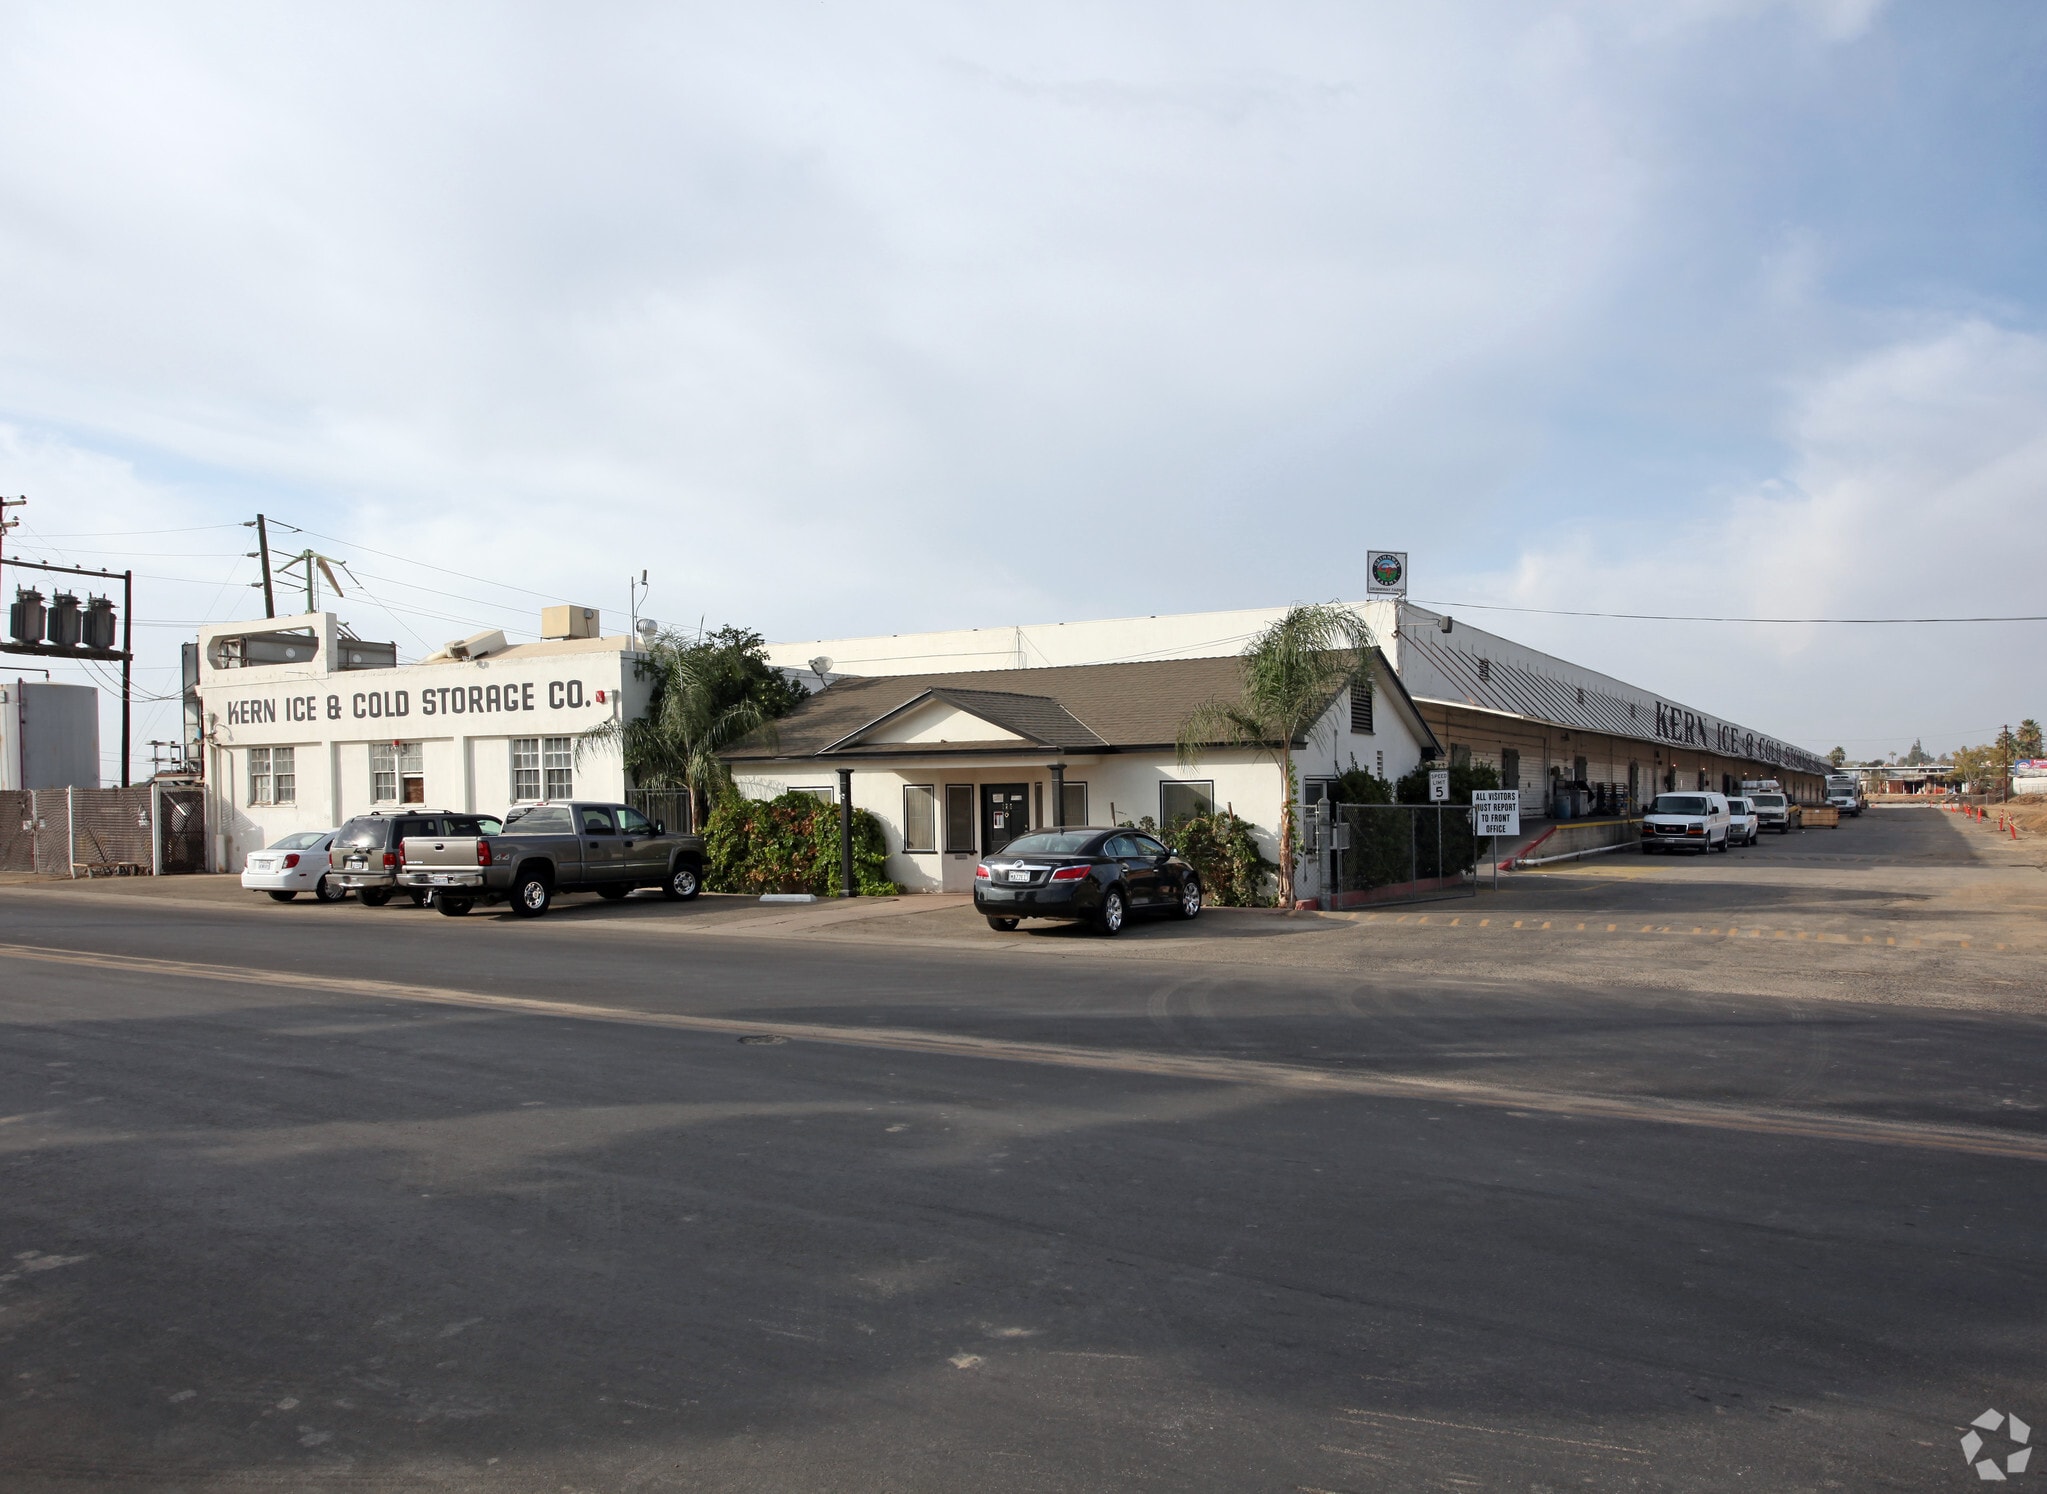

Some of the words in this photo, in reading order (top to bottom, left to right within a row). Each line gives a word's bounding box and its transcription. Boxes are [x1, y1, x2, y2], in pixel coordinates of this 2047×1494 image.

[227, 698, 275, 725] KERN
[286, 696, 316, 722] ICE
[327, 694, 342, 720] &
[353, 690, 409, 719] COLD
[422, 682, 534, 715] STORAGE
[548, 679, 592, 709] CO.
[1655, 700, 1707, 747] KERN
[1717, 722, 1739, 753] ICE
[1746, 732, 1754, 757] &
[1759, 737, 1781, 764] COLD
[1435, 786, 1443, 797] 5
[1475, 792, 1486, 800] ALL
[1488, 792, 1516, 800] VISITORS
[1493, 803, 1516, 811] REPORT
[1481, 814, 1488, 822] TO
[1491, 814, 1510, 822] FRONT
[1485, 825, 1506, 833] OFFICE
